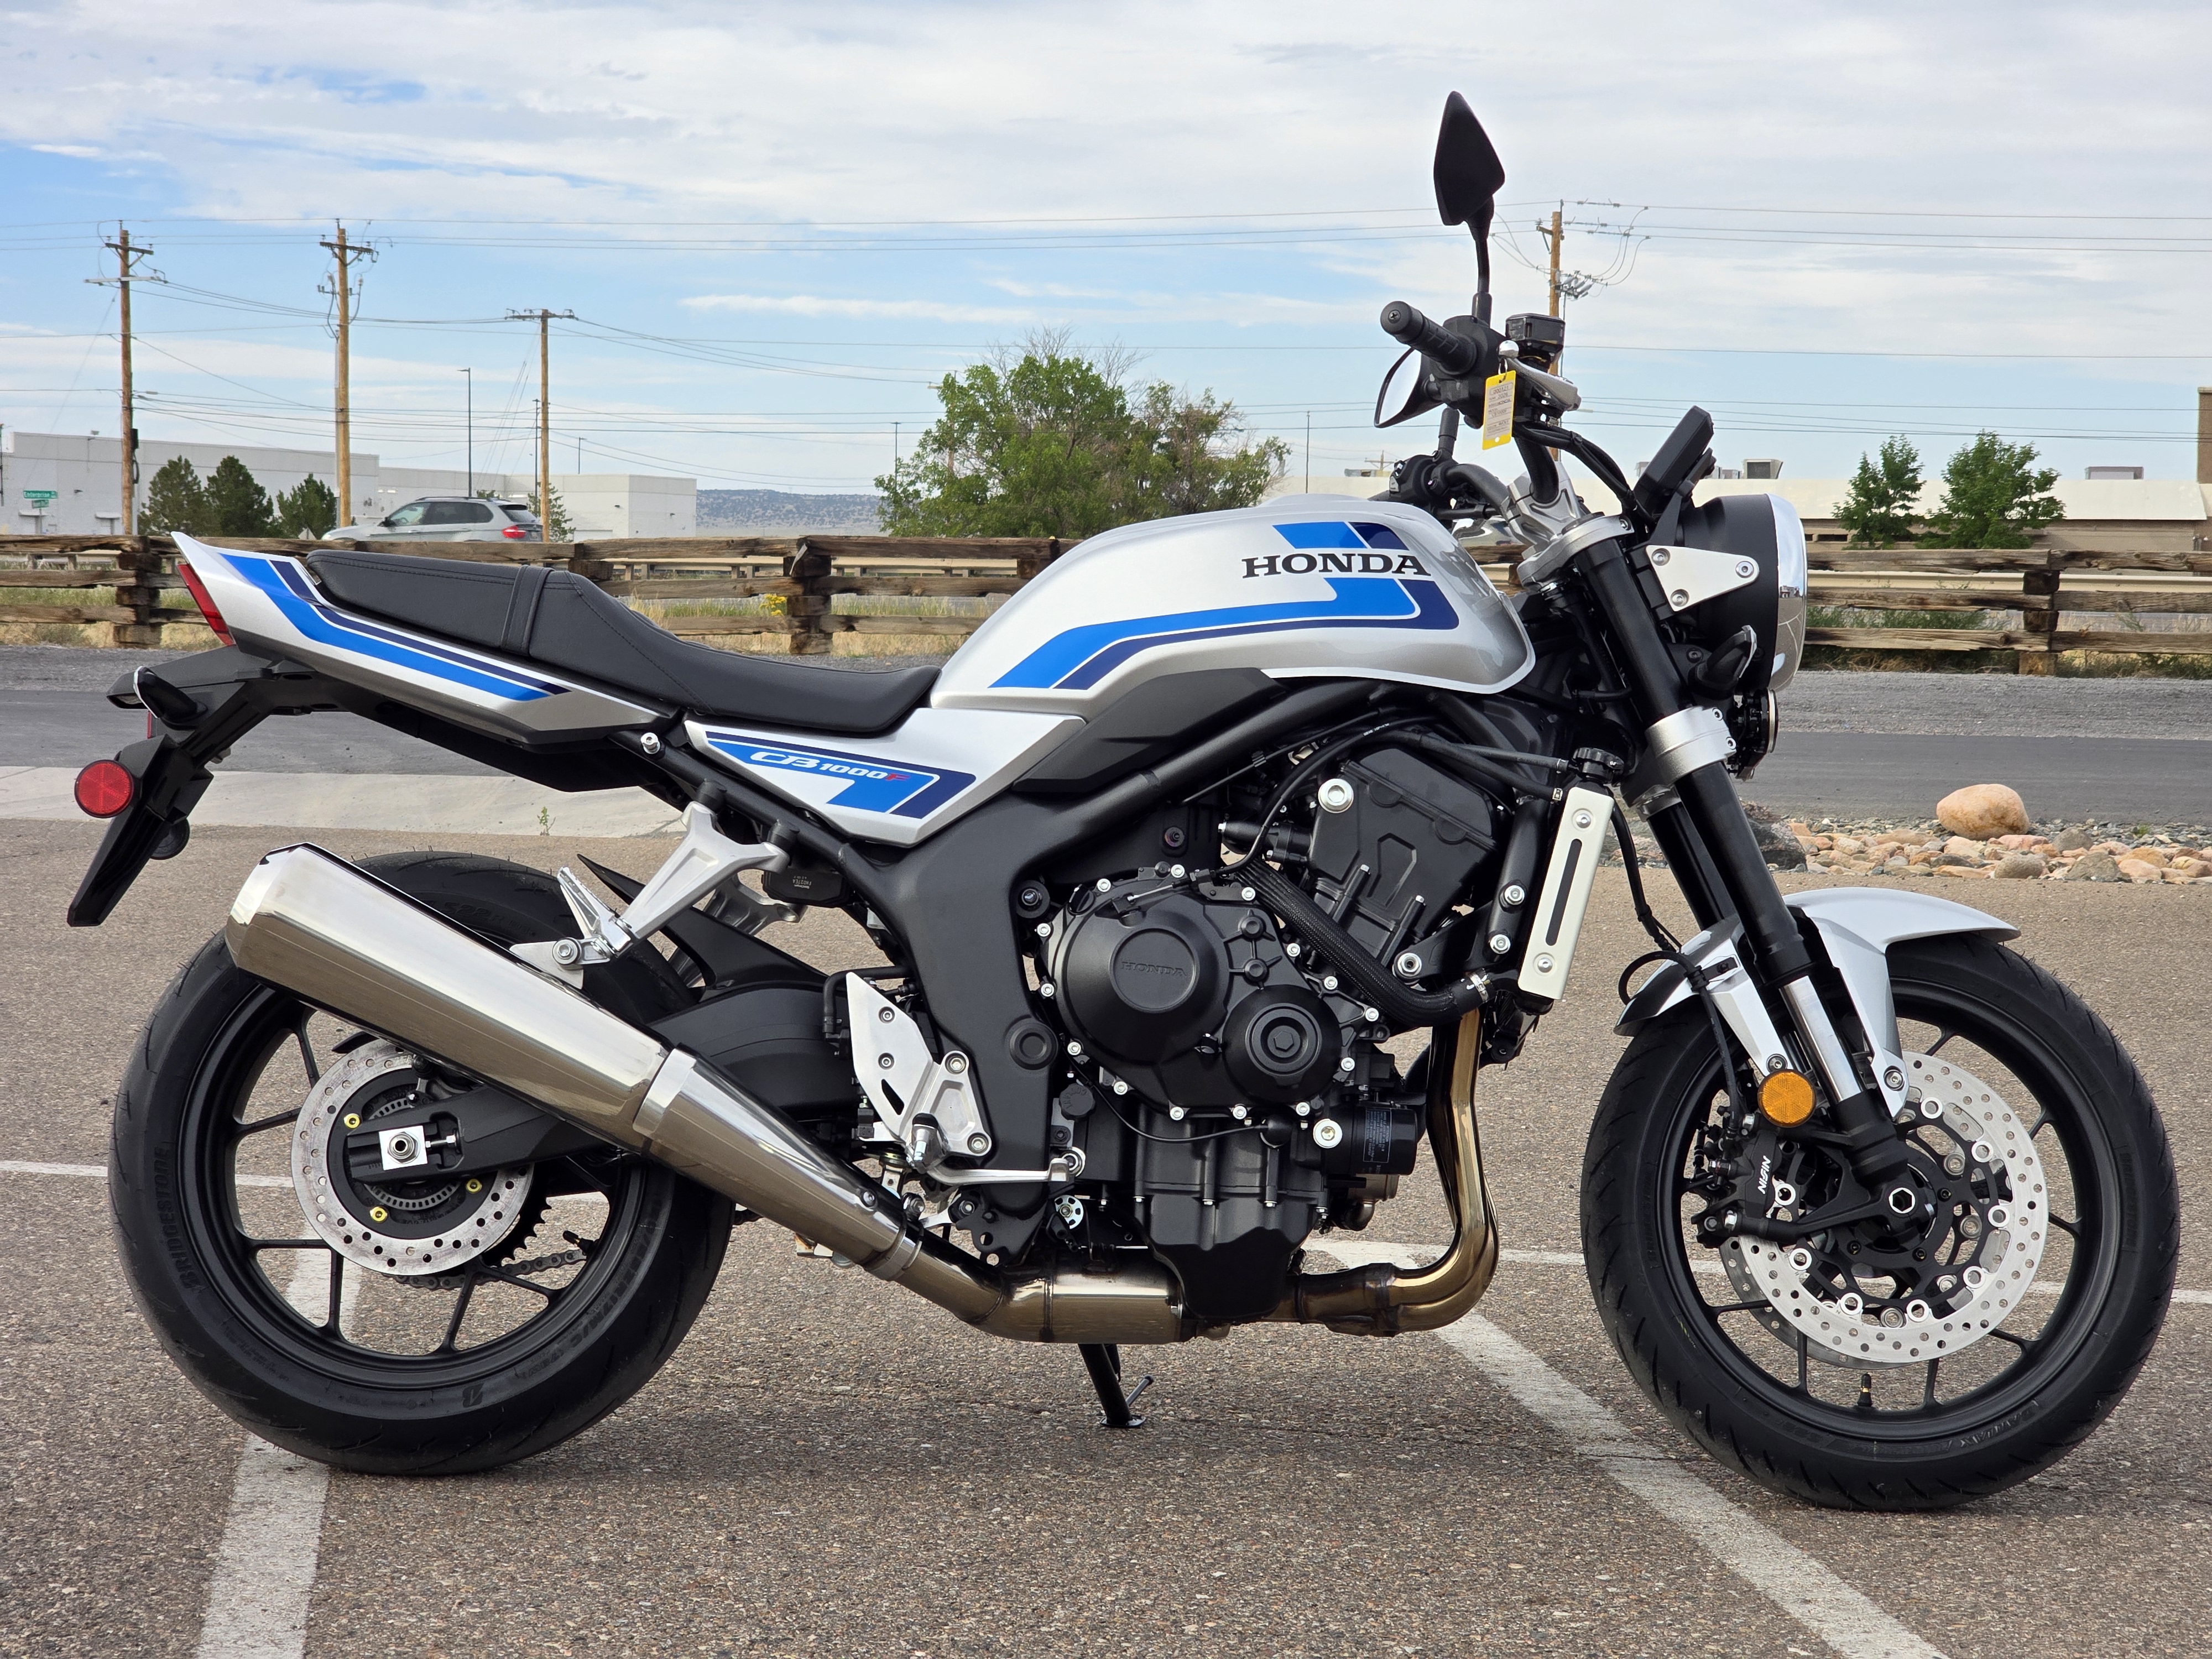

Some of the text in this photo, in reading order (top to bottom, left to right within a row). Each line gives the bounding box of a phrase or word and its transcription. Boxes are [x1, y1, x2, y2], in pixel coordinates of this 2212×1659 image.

[1241, 553, 1432, 579] HONDA
[750, 751, 910, 781] CB1000F
[1121, 961, 1188, 978] HONDA
[154, 1146, 206, 1292] BRIDGESTONE
